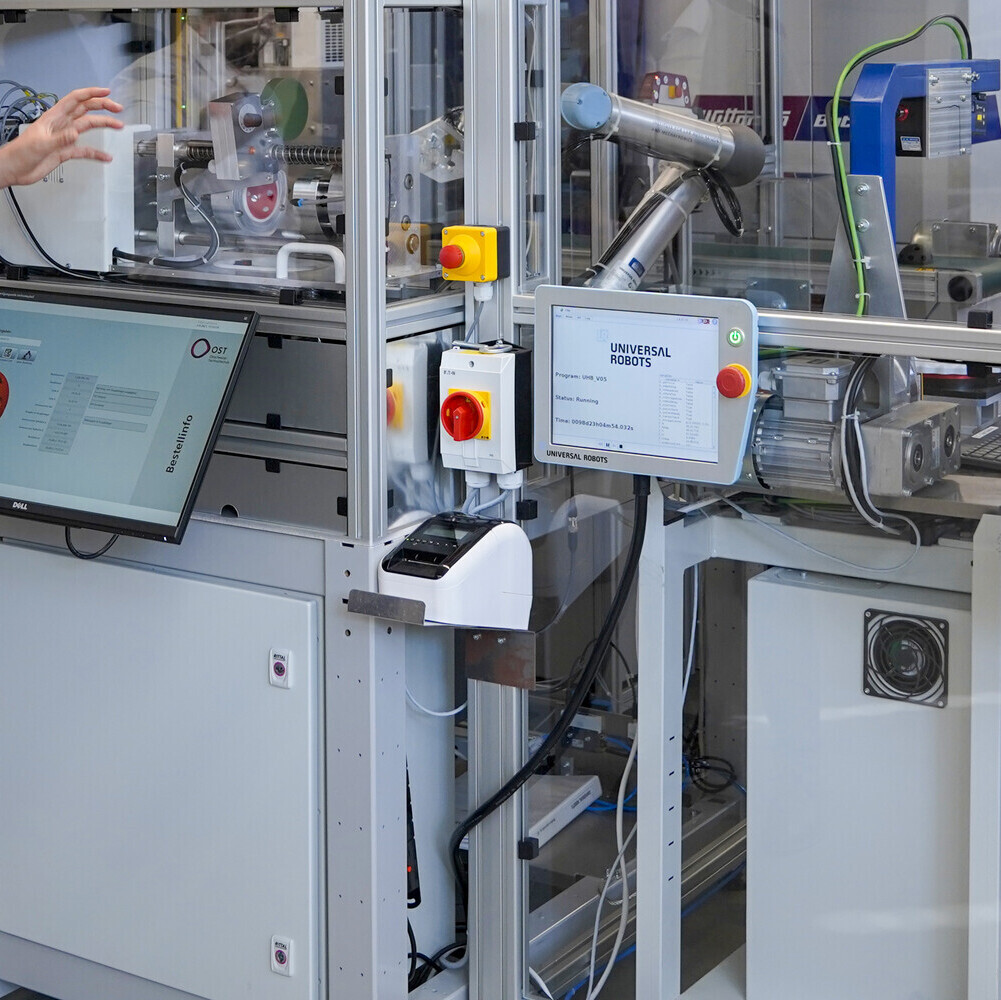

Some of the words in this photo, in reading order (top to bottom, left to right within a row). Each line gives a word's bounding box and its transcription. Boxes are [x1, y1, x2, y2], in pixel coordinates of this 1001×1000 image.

[211, 346, 228, 355] OST
[610, 342, 671, 358] UNIVERSAL
[610, 355, 652, 368] ROBOTS
[576, 397, 599, 405] Running
[166, 414, 193, 473] Bestellinfo
[547, 450, 581, 461] UNIVERSAL
[584, 454, 608, 464] ROBOTS
[12, 501, 27, 510] DELL
